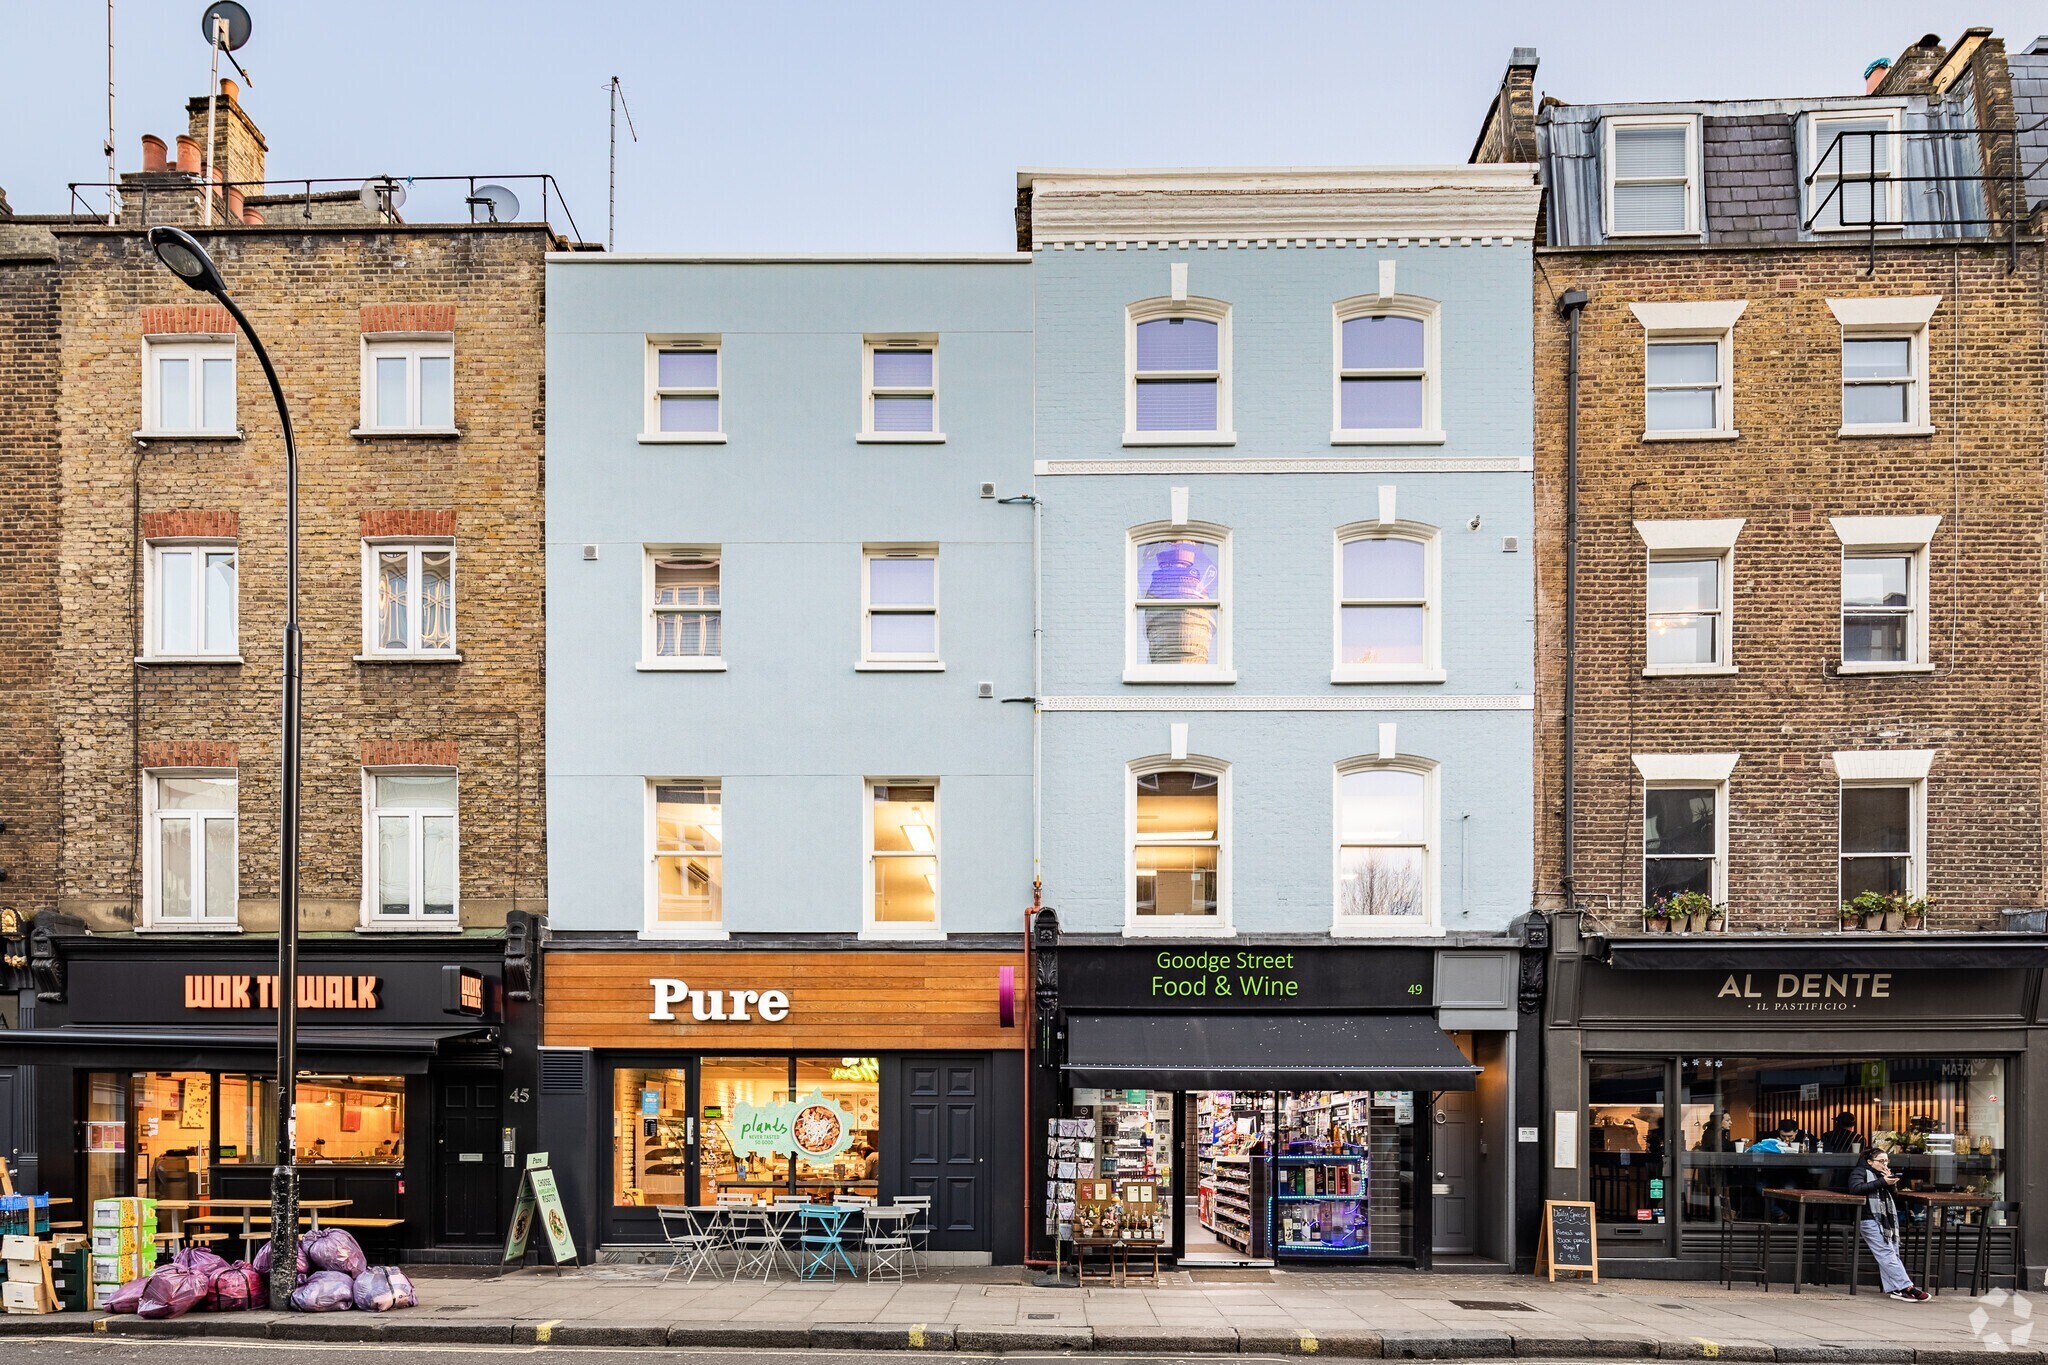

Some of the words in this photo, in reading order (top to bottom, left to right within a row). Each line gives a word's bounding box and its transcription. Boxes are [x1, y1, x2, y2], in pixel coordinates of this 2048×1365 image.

[1157, 952, 1231, 972] Goodge
[1236, 951, 1294, 969] Street
[185, 975, 251, 1008] WOK
[297, 975, 377, 1008] WALK
[461, 975, 482, 998] WOK
[1152, 975, 1207, 996] Food
[1214, 976, 1232, 996] &
[1239, 975, 1299, 996] Wine
[1407, 984, 1423, 995] 49
[1717, 974, 1762, 998] AL
[1776, 974, 1892, 998] DENTE
[649, 978, 790, 1022] Pure
[1774, 1003, 1848, 1011] PASTIFICIO
[509, 1087, 530, 1103] 45
[741, 1113, 788, 1140] plants
[1553, 1208, 1569, 1220] Daily
[1569, 1208, 1587, 1221] Special
